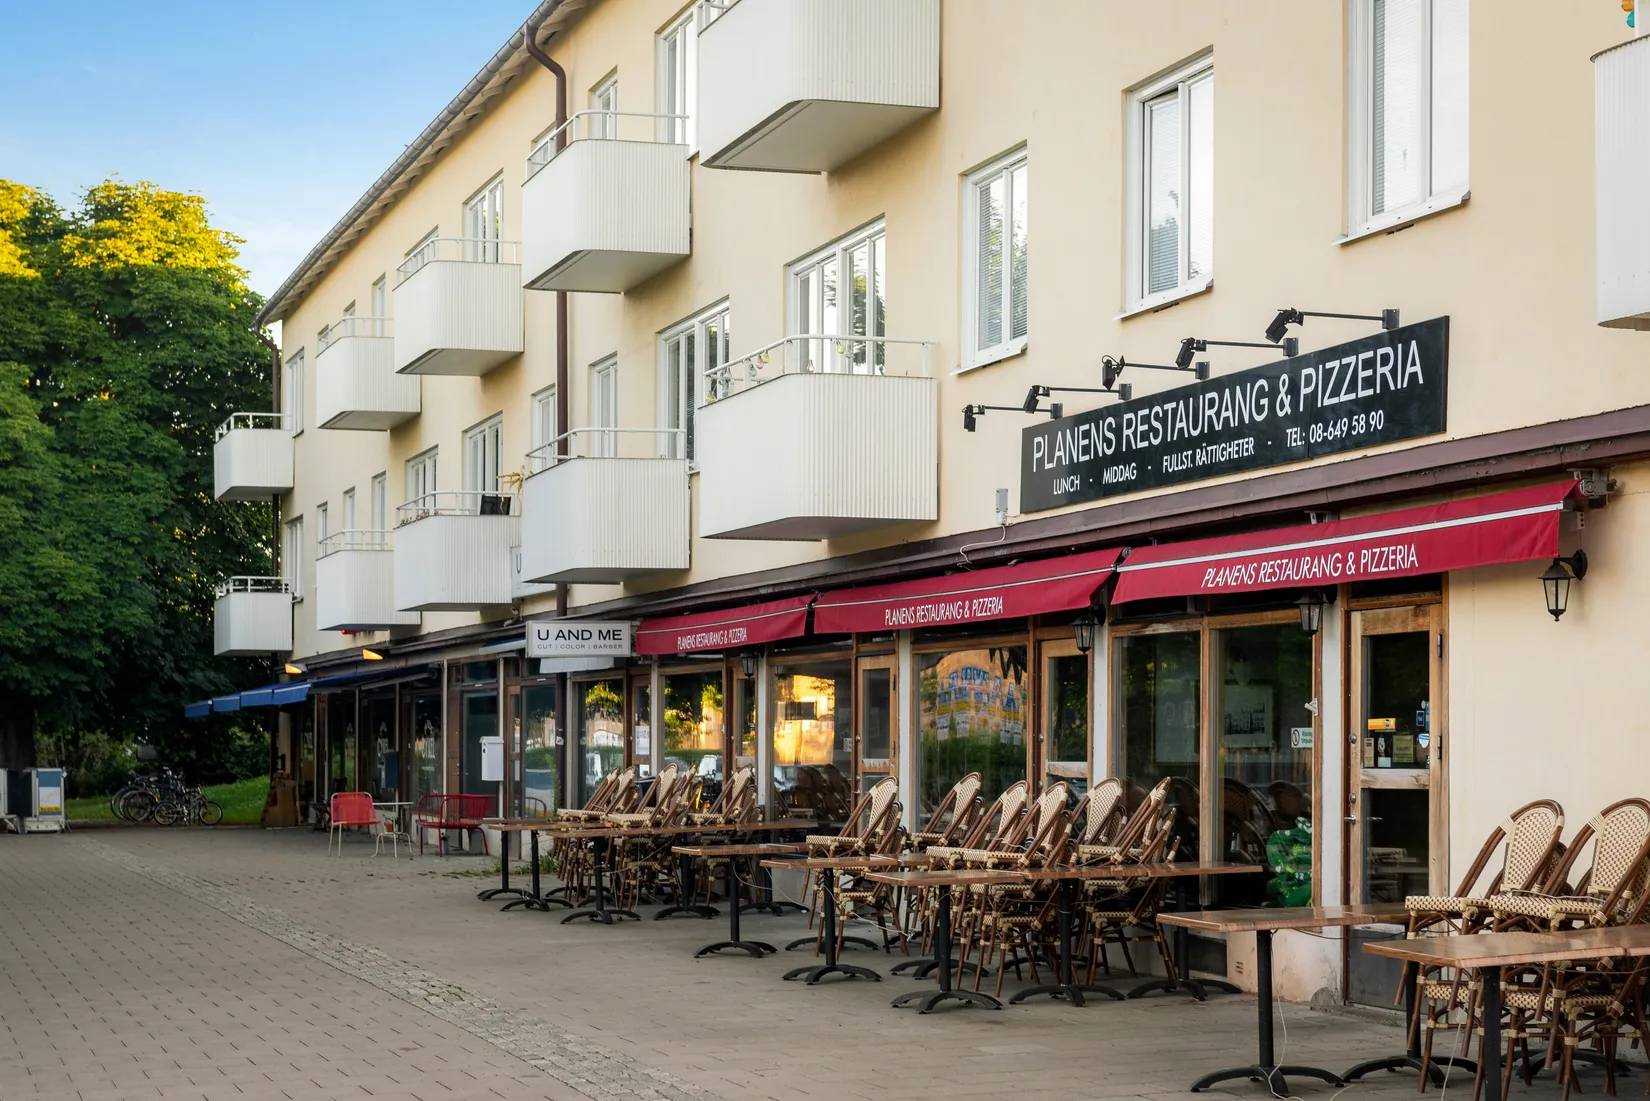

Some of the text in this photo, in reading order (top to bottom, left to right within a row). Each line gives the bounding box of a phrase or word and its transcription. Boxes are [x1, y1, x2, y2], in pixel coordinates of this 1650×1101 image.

[1033, 340, 1424, 472] PLANENS RESTAURANG & PIZZERIA
[1053, 410, 1384, 495] LUNCH MIDDAG FULLST. RÄTTIGHETER TEL: 08-649 58 90
[1201, 543, 1419, 588] PLANENS RESTAURANG & PIZZERIA
[885, 596, 1004, 626] PLANENS RESTAURANG & PIZZERIA
[537, 629, 623, 641] U AND ME
[677, 634, 696, 650] PLANENS
[696, 631, 724, 648] RESTAURANG
[728, 627, 748, 643] PIZZERIA
